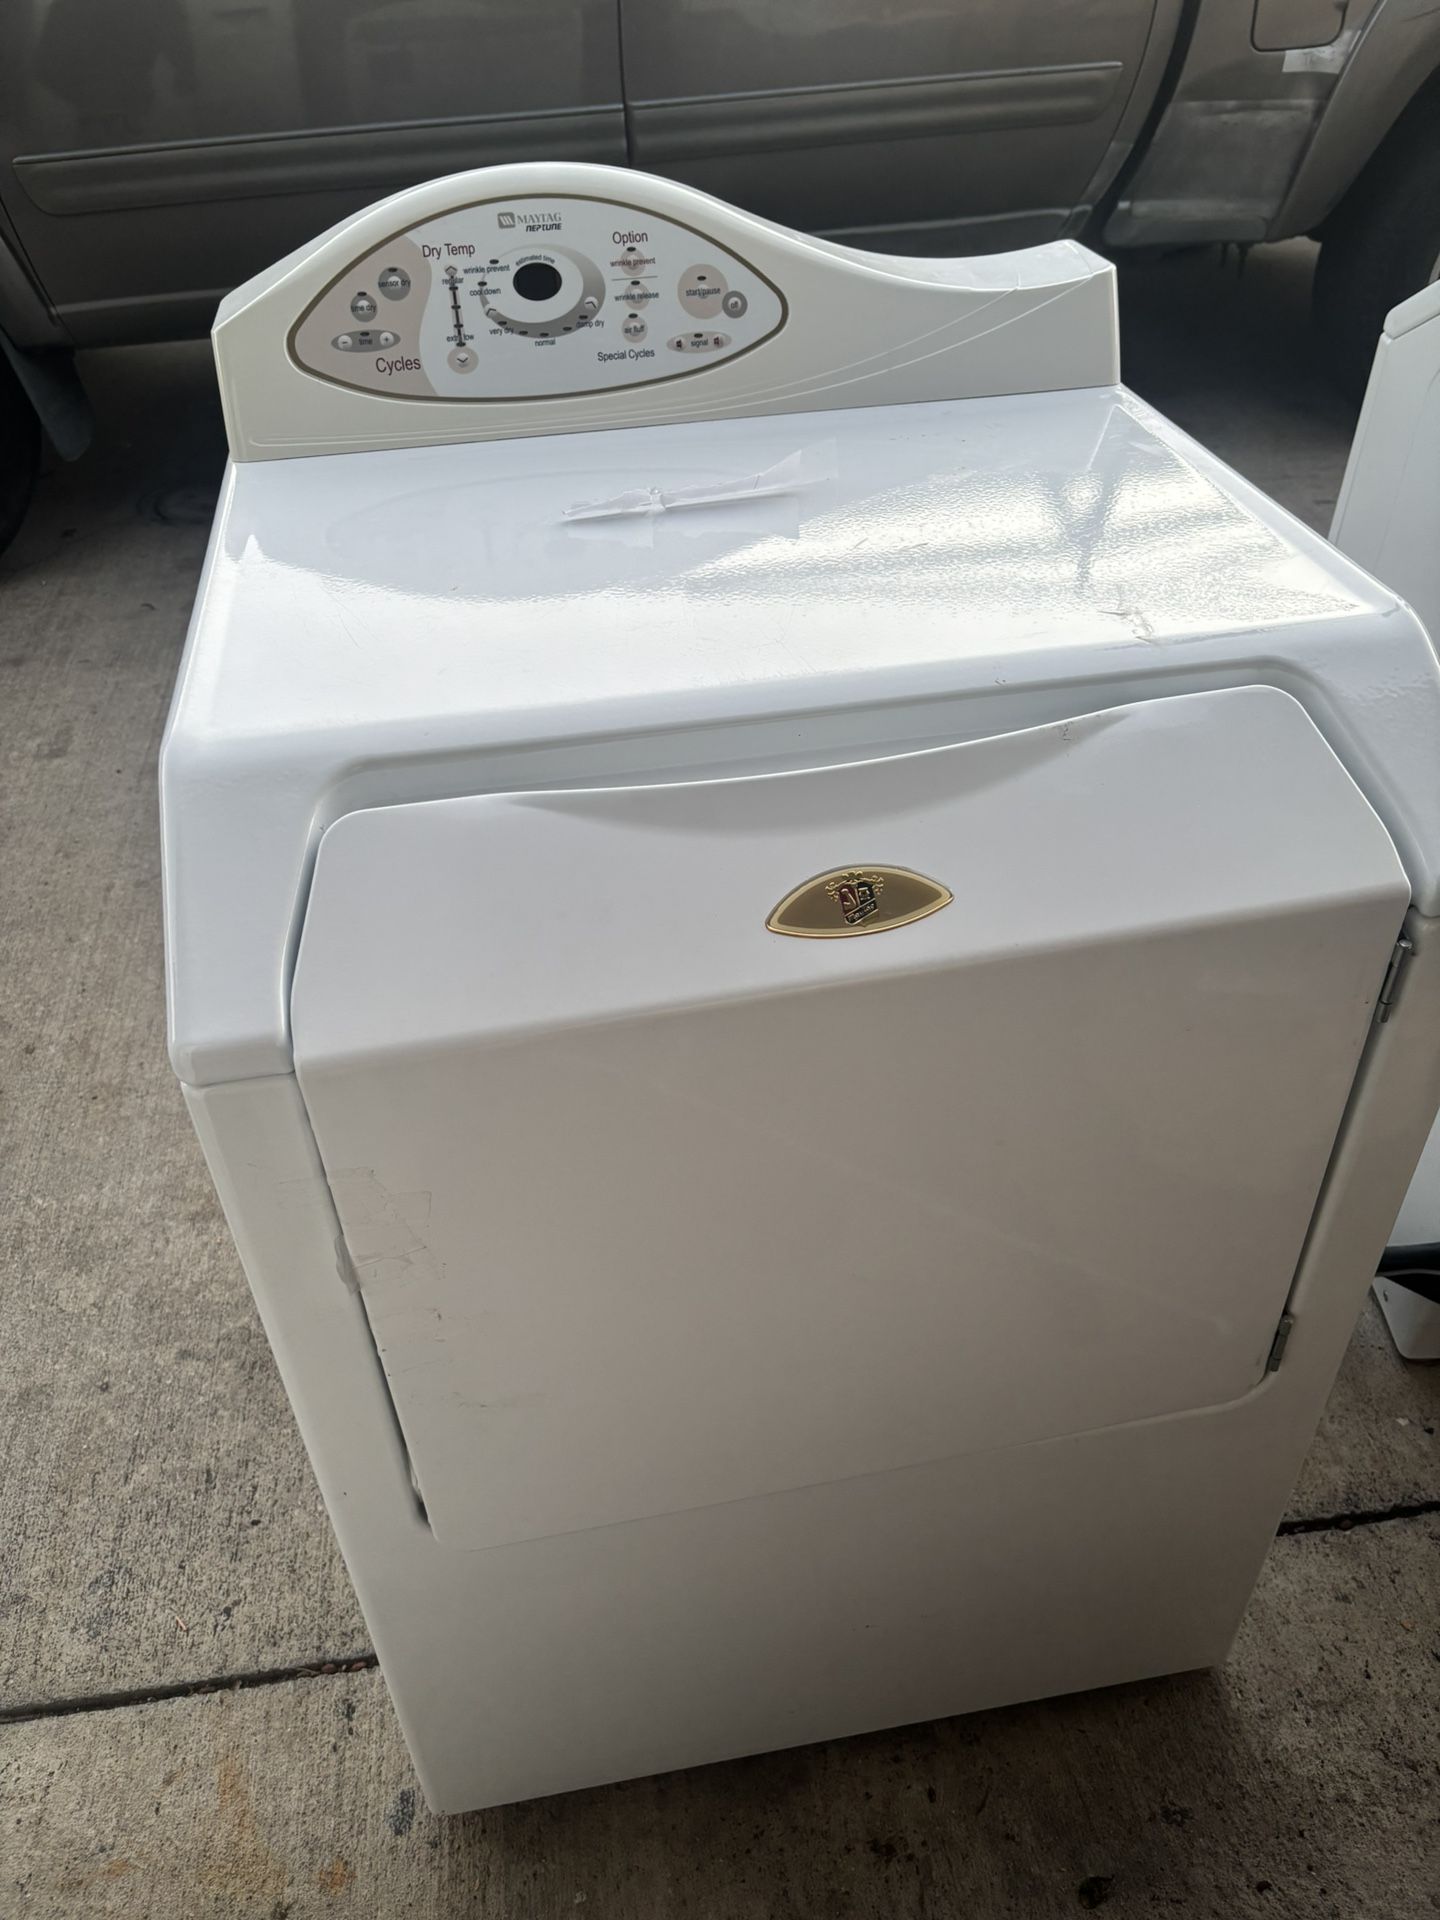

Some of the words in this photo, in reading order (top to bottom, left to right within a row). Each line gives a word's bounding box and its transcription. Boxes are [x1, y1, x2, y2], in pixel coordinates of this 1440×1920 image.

[517, 212, 562, 224] MAYTAG
[612, 231, 649, 246] Option
[422, 245, 442, 260] Dry
[444, 243, 476, 257] Temp
[609, 259, 632, 267] wrinkle
[632, 257, 656, 267] prevent
[463, 266, 486, 274] wrinkle
[486, 264, 511, 274] prevent
[400, 279, 411, 288] dry
[482, 289, 501, 297] down
[614, 294, 637, 302] wrinkle
[637, 292, 659, 300] release
[366, 303, 377, 313] dry
[594, 319, 605, 328] dry
[489, 328, 503, 336] very
[503, 326, 514, 336] dry
[534, 338, 556, 347] normal
[691, 338, 709, 348] signal
[597, 350, 627, 363] Special
[628, 348, 655, 361] Cycles
[375, 356, 421, 376] Cycles
